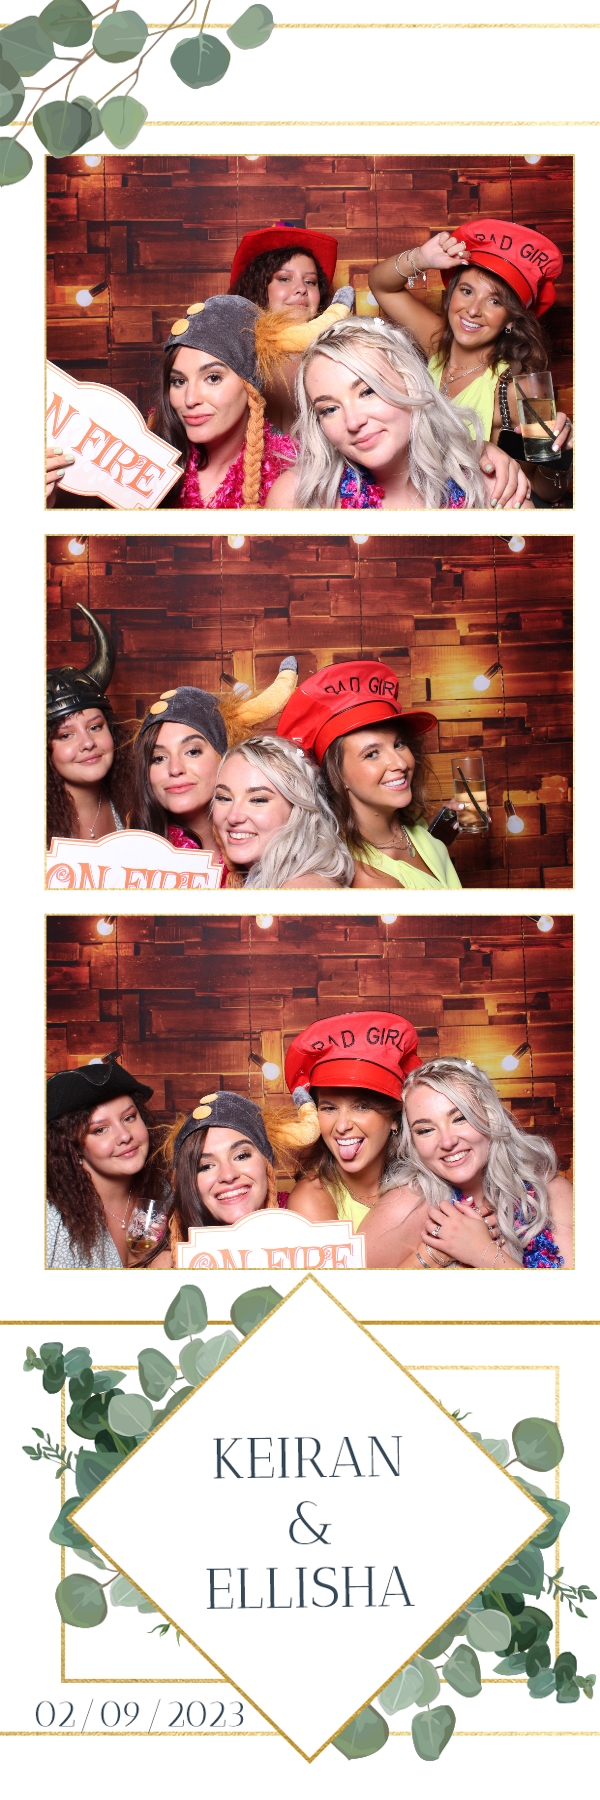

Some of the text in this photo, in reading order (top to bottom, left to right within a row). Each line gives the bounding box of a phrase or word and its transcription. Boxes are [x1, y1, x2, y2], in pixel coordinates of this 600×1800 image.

[520, 243, 552, 276] GIRL
[71, 418, 166, 499] FIRE
[45, 862, 112, 889] ON
[366, 1026, 404, 1052] GIRL
